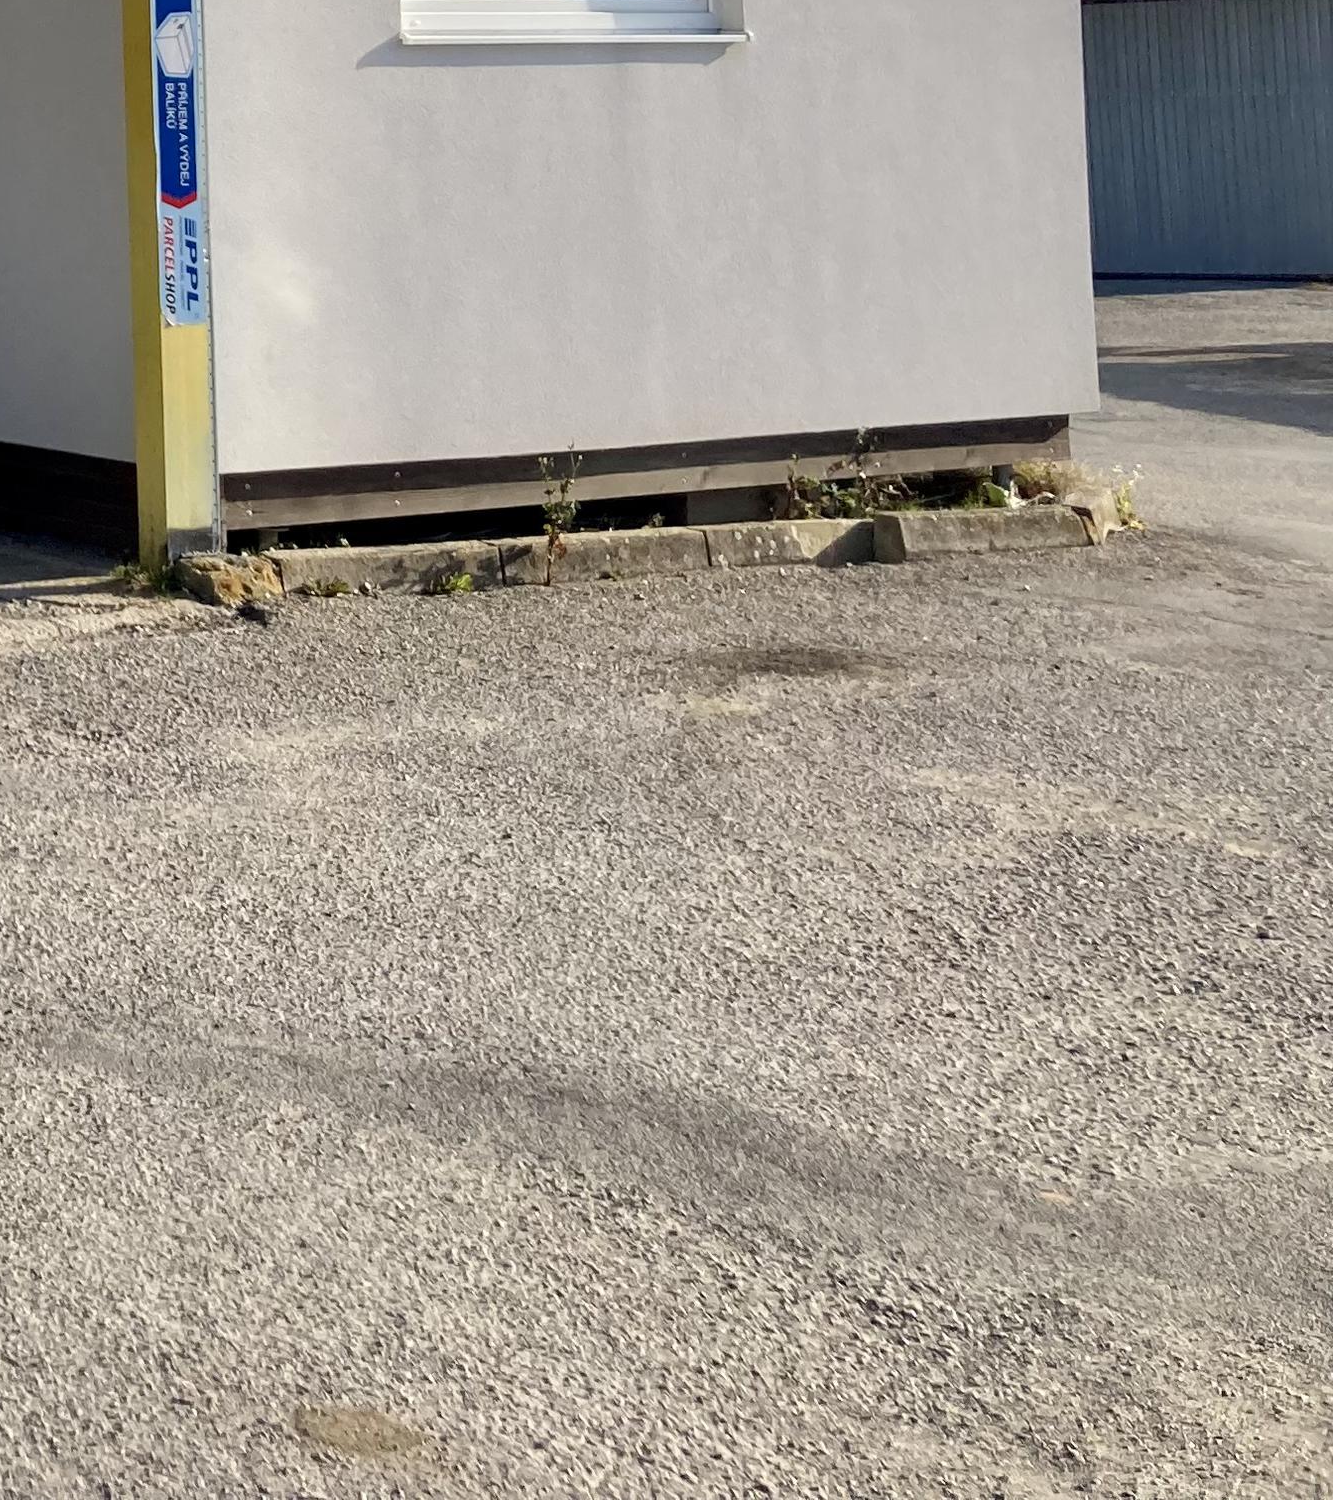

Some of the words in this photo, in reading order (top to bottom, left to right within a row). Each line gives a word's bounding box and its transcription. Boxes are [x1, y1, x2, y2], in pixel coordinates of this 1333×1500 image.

[178, 132, 189, 142] A
[179, 145, 190, 187] VÝDEJ
[164, 216, 176, 315] PARCELSHOP
[185, 239, 199, 311] PPL
